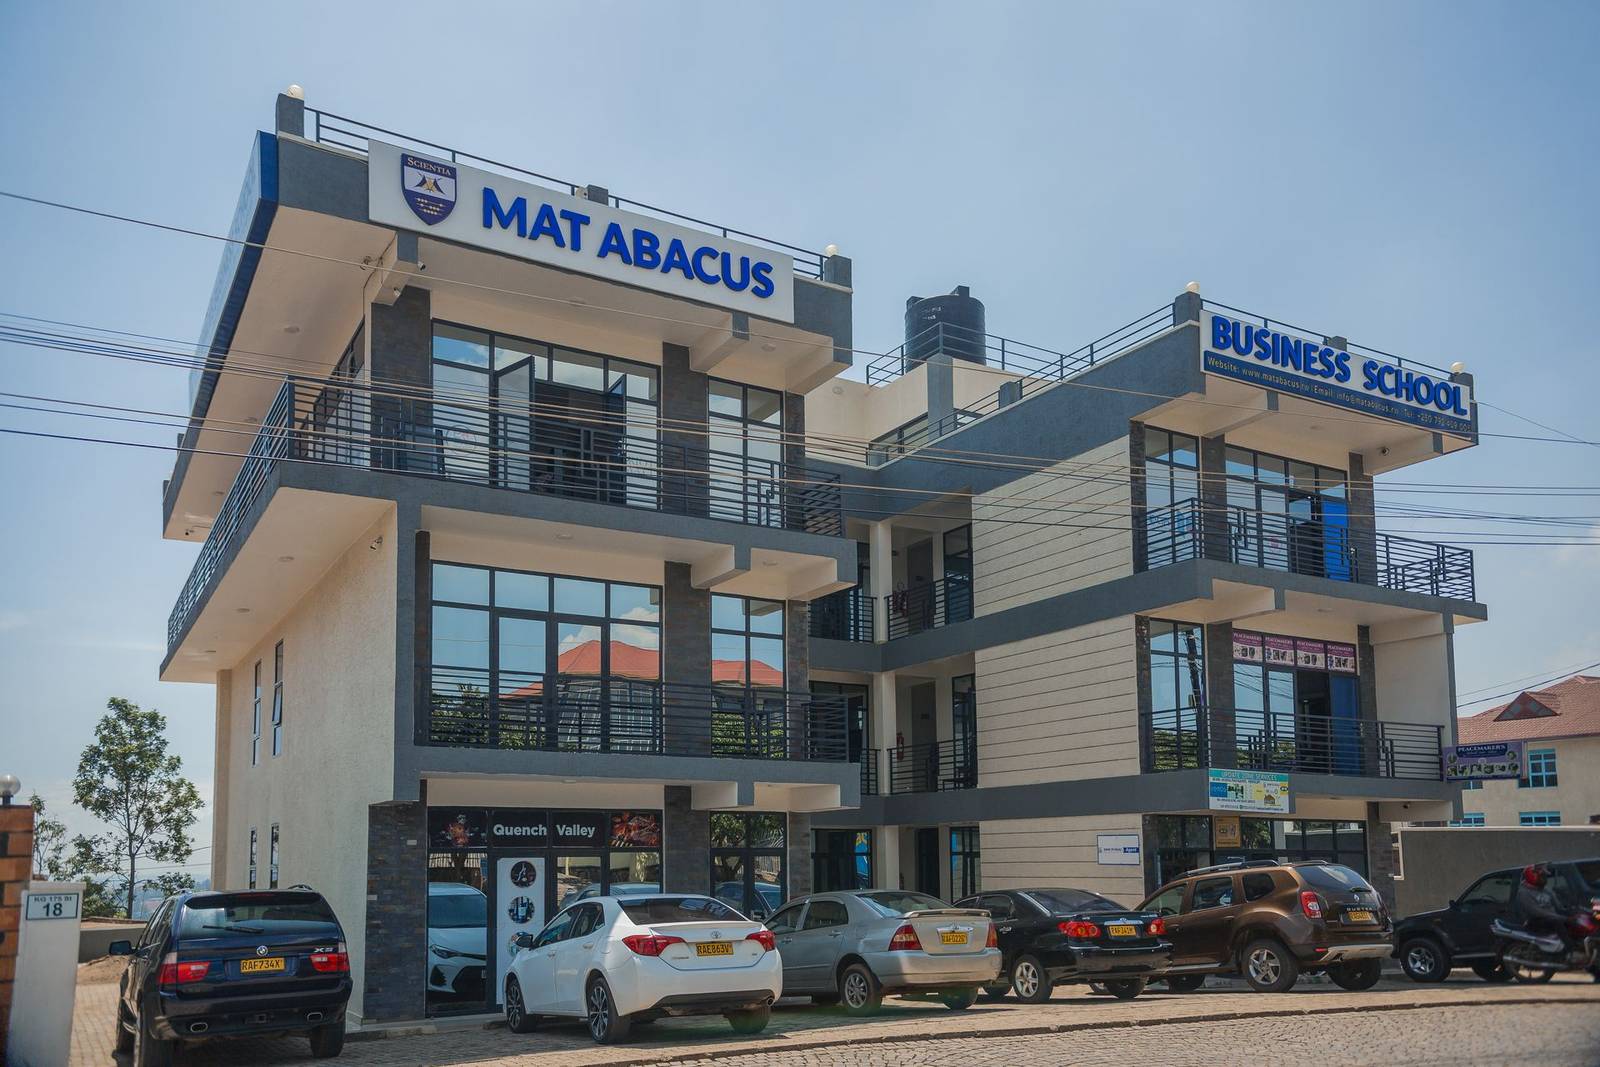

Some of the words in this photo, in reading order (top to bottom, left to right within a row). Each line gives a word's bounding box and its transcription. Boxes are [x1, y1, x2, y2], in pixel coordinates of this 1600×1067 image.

[482, 186, 590, 251] MAT
[597, 222, 775, 298] ABACUS
[1211, 315, 1351, 383] BUSINESS
[1363, 361, 1467, 416] SCHOOL
[493, 823, 547, 837] Quench
[556, 824, 596, 839] Valley
[43, 903, 63, 917] 18
[242, 959, 281, 971] RAF734X
